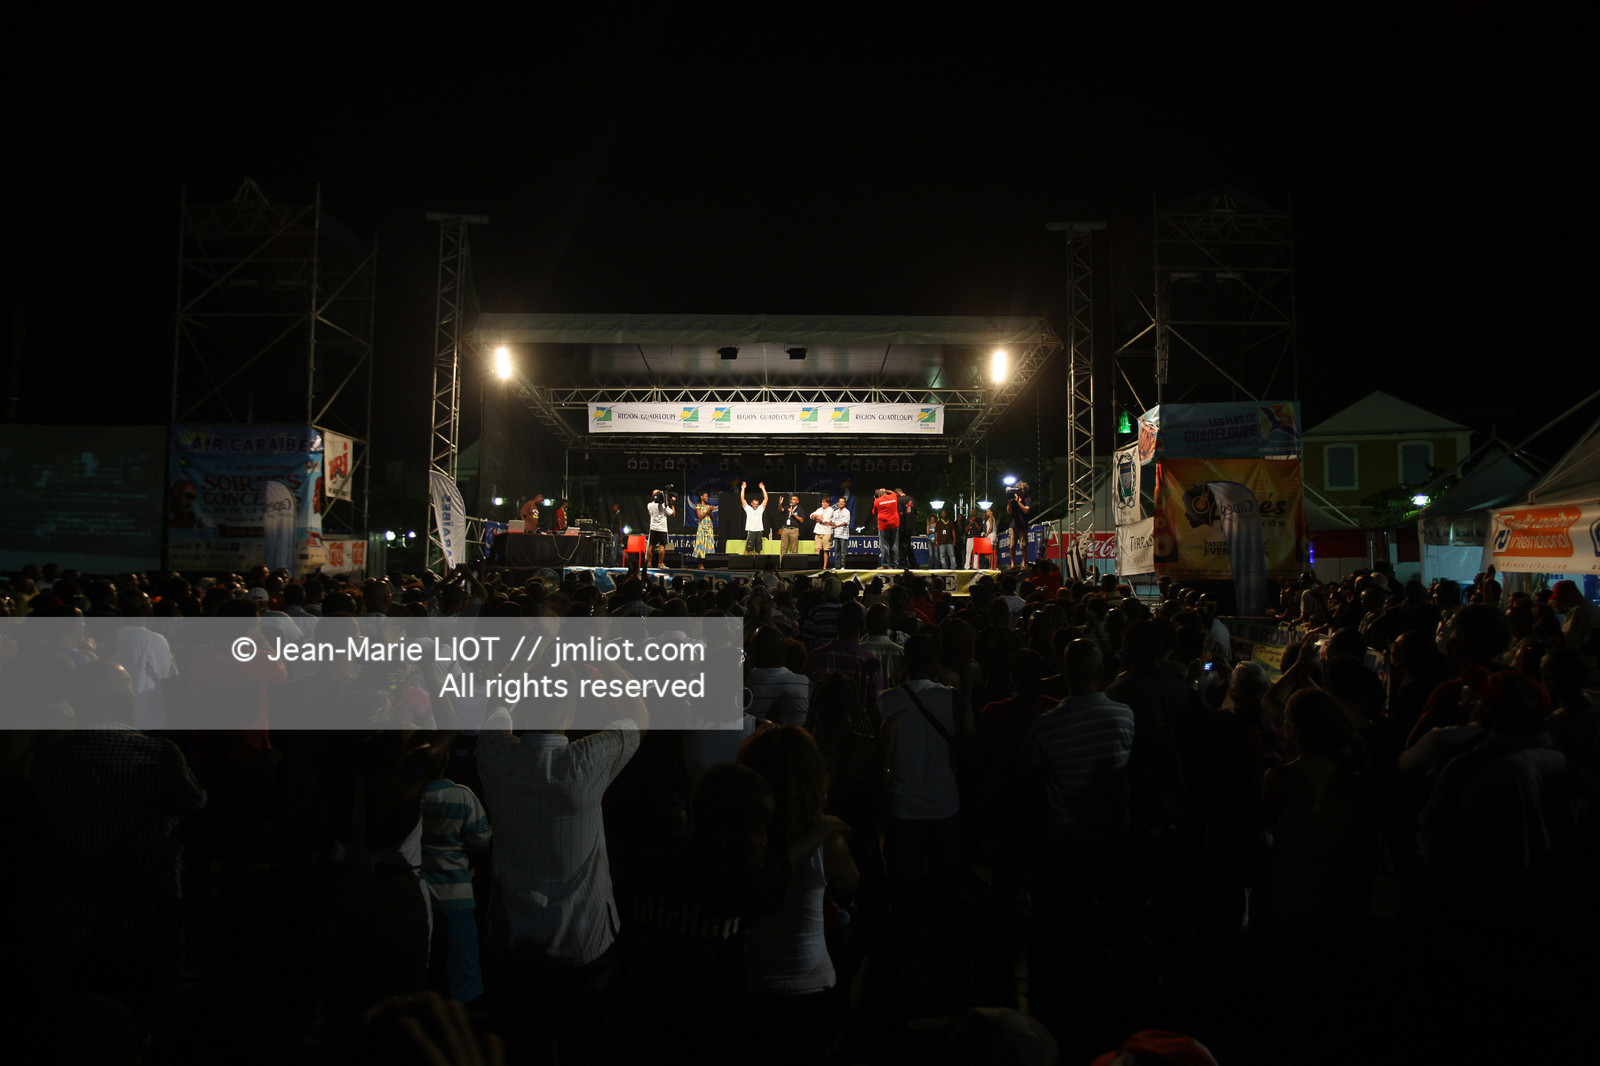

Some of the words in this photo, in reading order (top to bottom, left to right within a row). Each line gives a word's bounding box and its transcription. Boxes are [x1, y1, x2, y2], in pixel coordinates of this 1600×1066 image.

[760, 413, 795, 421] GUADELOUPE
[878, 413, 914, 421] GUADELOUPE
[1246, 413, 1257, 423] DE
[1183, 424, 1260, 443] GUADELOUPE
[190, 437, 224, 452] AIR
[202, 472, 302, 491] SOIRS
[863, 540, 872, 549] LA
